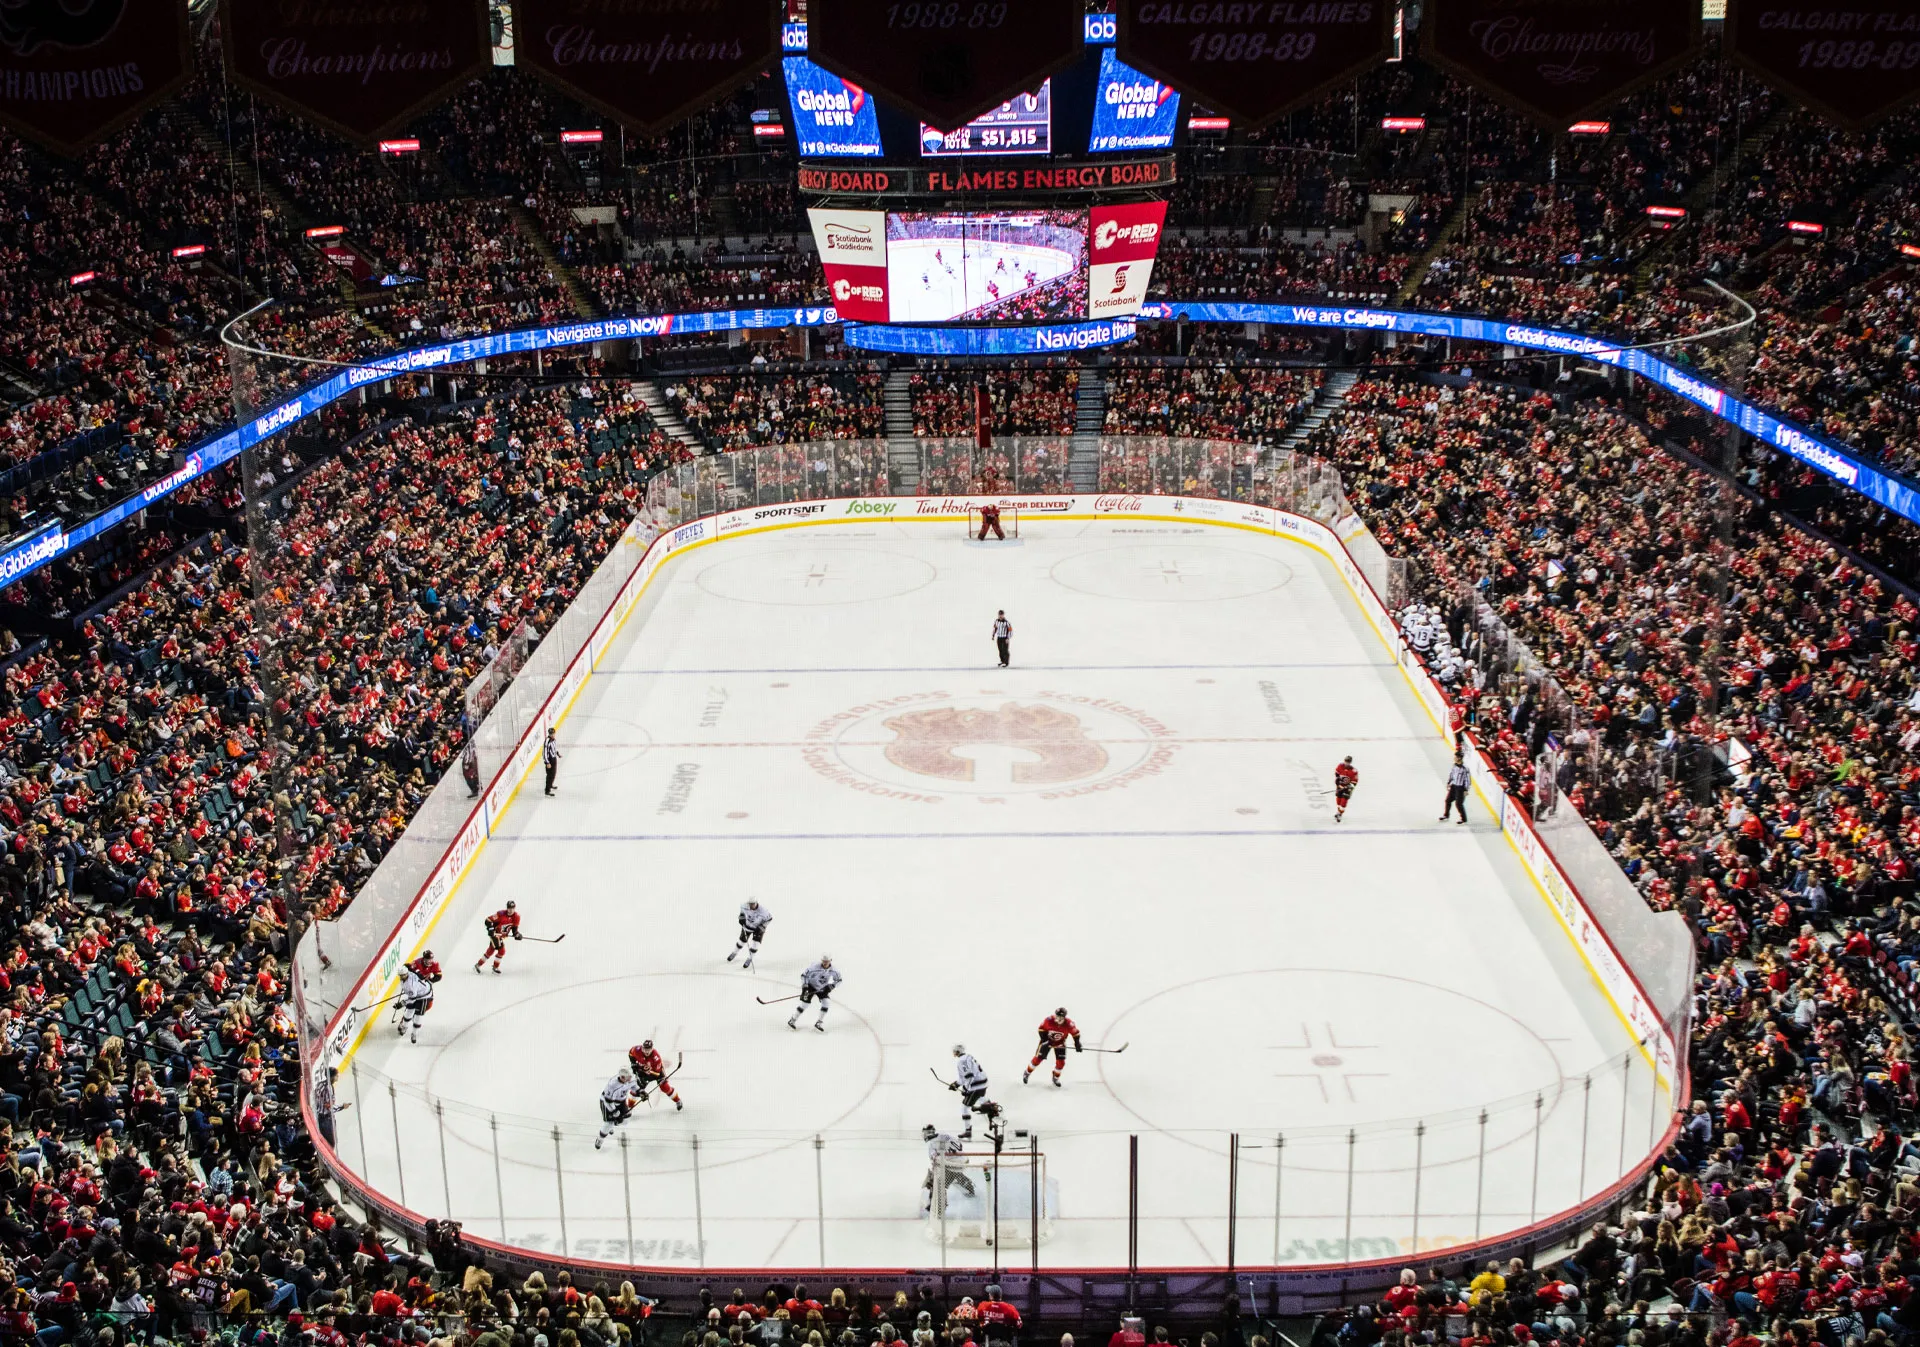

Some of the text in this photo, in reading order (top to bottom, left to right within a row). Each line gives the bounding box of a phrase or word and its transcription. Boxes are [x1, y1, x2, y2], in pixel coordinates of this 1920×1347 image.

[886, 3, 1008, 29] 1988-89
[1138, 3, 1373, 25] CALGARY FLAMES
[1758, 9, 1920, 32] CALGARY FLA
[545, 23, 744, 76] Champions
[1187, 31, 1317, 62] 1988-89
[1468, 15, 1657, 80] Champions
[1797, 39, 1920, 70] 1988-89
[260, 36, 456, 86] Champions
[797, 88, 851, 112] Global
[1105, 81, 1160, 104] Global
[814, 110, 854, 126] NEWS
[1116, 103, 1160, 120] NEWS
[944, 138, 971, 150] TOTAL
[981, 128, 1038, 149] $51,815
[831, 172, 889, 191] BOARD
[928, 170, 1018, 191] FLAMES
[1023, 166, 1107, 189] ENERGY
[1111, 163, 1160, 185] BOARD
[835, 234, 872, 243] Scotiabank
[1130, 223, 1158, 239] RED
[836, 243, 873, 251] Saddledome
[861, 285, 884, 298] RED
[1094, 296, 1138, 309] Scotiabank
[1292, 307, 1397, 330] We are Calgary
[546, 316, 668, 344] Navigate the NOW
[1036, 326, 1110, 350] Navigate
[1112, 321, 1128, 338] the
[256, 399, 302, 436] We are Calgary
[754, 504, 827, 520] SPORTSNET
[845, 500, 897, 515] Sobeys
[916, 499, 938, 514] Tim
[1030, 500, 1069, 509] DELIVERY
[674, 522, 704, 543] POPEYE'S
[1417, 631, 1428, 641] 13
[800, 744, 945, 804] Saddledome
[449, 821, 481, 881] RE/MAX
